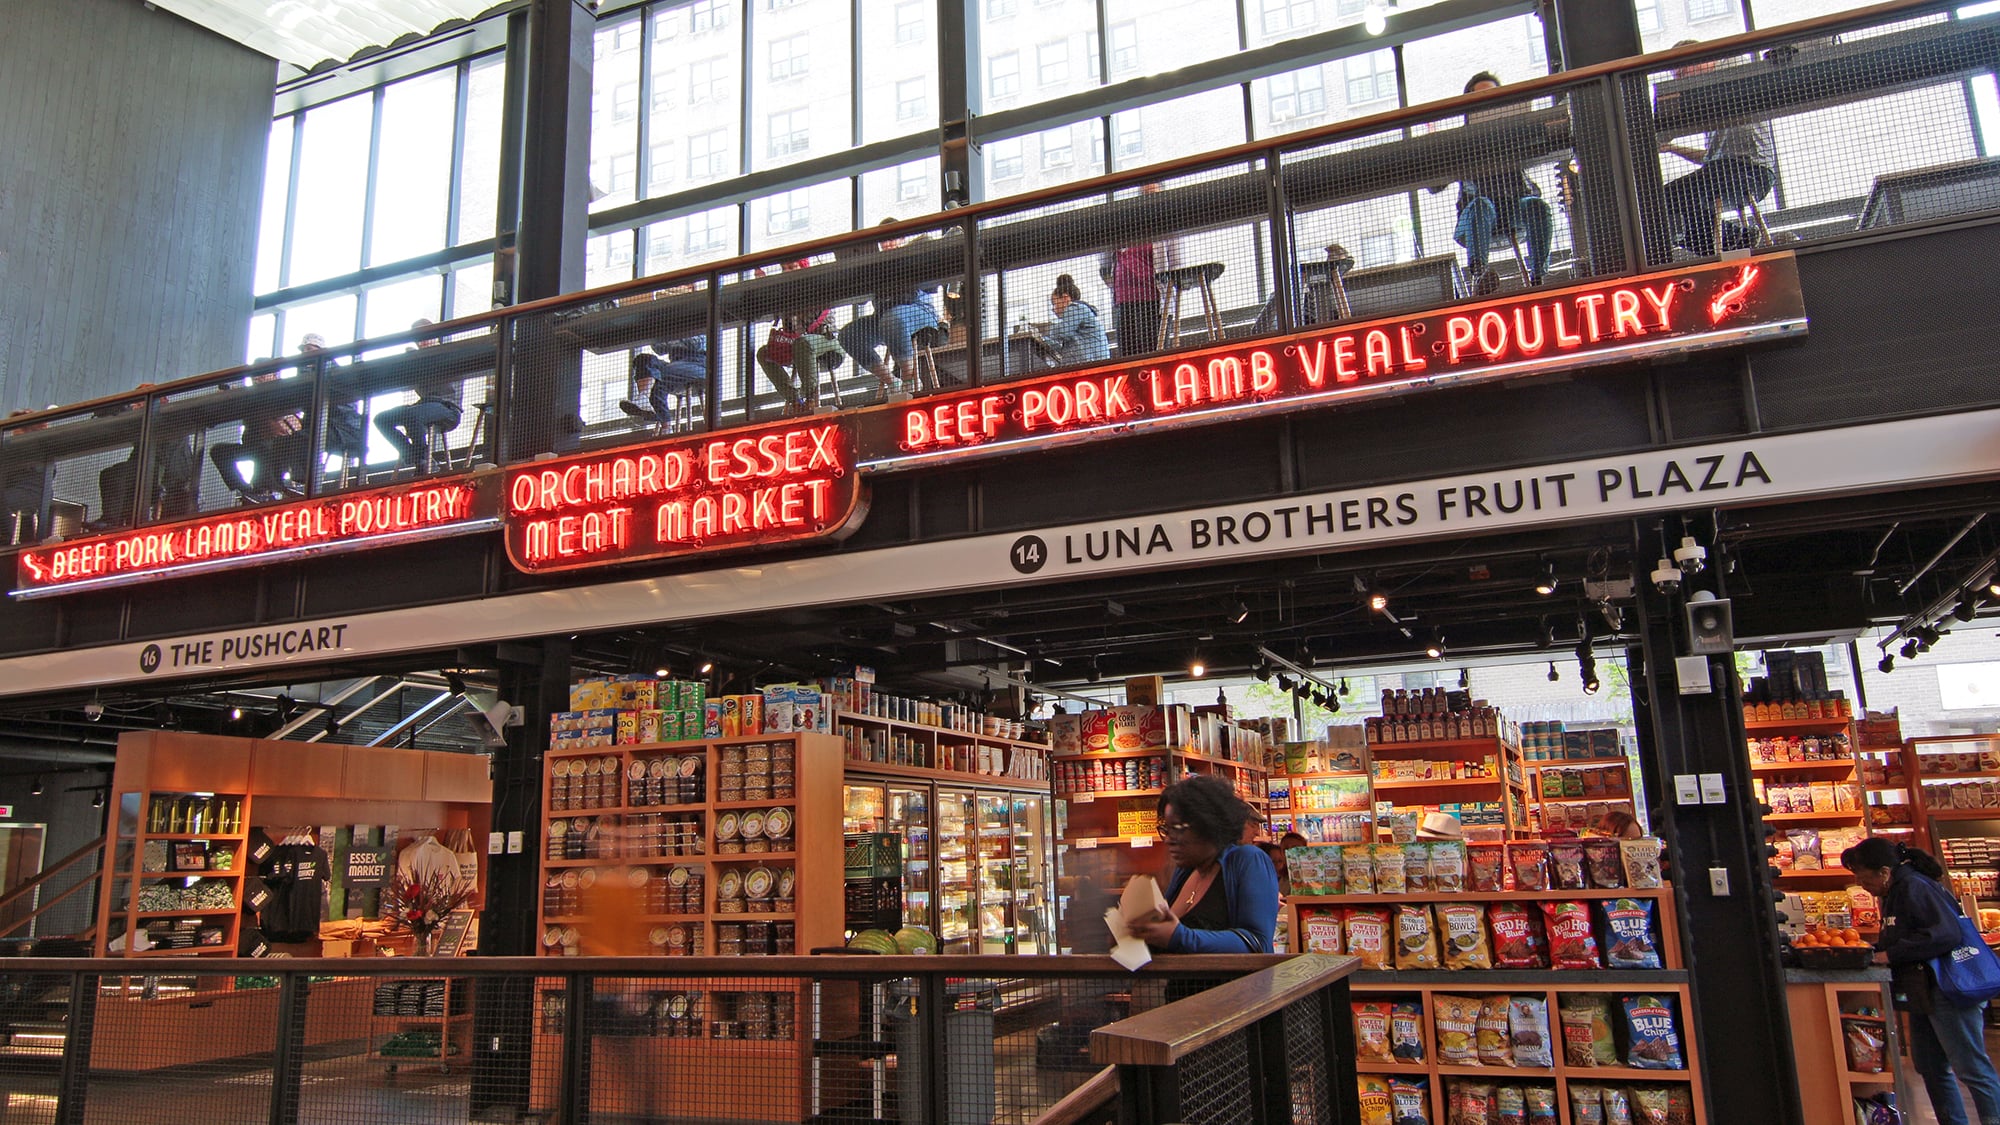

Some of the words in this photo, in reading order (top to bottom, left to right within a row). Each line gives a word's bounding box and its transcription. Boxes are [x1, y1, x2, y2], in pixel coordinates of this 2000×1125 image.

[906, 396, 1004, 448] BEEF
[1022, 374, 1133, 430] PORK
[1151, 352, 1277, 409] LAMB
[1298, 327, 1425, 387] VEAL
[1446, 282, 1676, 364] POULTRY
[512, 451, 684, 512] ORCHARD
[708, 425, 834, 483] ESSEX
[1016, 543, 1040, 566] 14
[1065, 523, 1173, 564] LUNA
[1191, 492, 1418, 550] BROTHERS
[1438, 472, 1575, 521] FRUIT
[1598, 451, 1772, 502] PLAZA
[525, 508, 630, 560] MEAT
[657, 479, 827, 543] MARKET
[52, 541, 107, 579] BEEF
[116, 532, 174, 569] PORK
[186, 521, 254, 558] LAMB
[263, 507, 328, 544] VEAL
[341, 485, 461, 535] POULTRY
[143, 650, 156, 666] 16
[170, 640, 213, 667] THE
[221, 623, 348, 661] PUSHCART
[1119, 714, 1136, 722] CORN
[349, 852, 378, 864] ESSEX
[348, 864, 386, 877] MARKET
[1352, 923, 1379, 931] SWEET
[1400, 922, 1426, 931] BOWLS
[1449, 921, 1476, 931] BOWLS
[1494, 919, 1514, 934] RED
[1514, 919, 1531, 931] HO
[1552, 922, 1570, 937] RED
[1570, 918, 1590, 933] HOT
[1610, 918, 1648, 934] BLUE
[1351, 929, 1379, 937] POTATO
[1505, 928, 1526, 938] Blues
[1620, 928, 1646, 938] Chips
[1394, 1020, 1415, 1028] BLUE
[1631, 1017, 1673, 1032] BLUE
[1643, 1028, 1669, 1038] Chips
[1359, 1097, 1392, 1109] YELLOW
[1366, 1104, 1386, 1113] Chips
